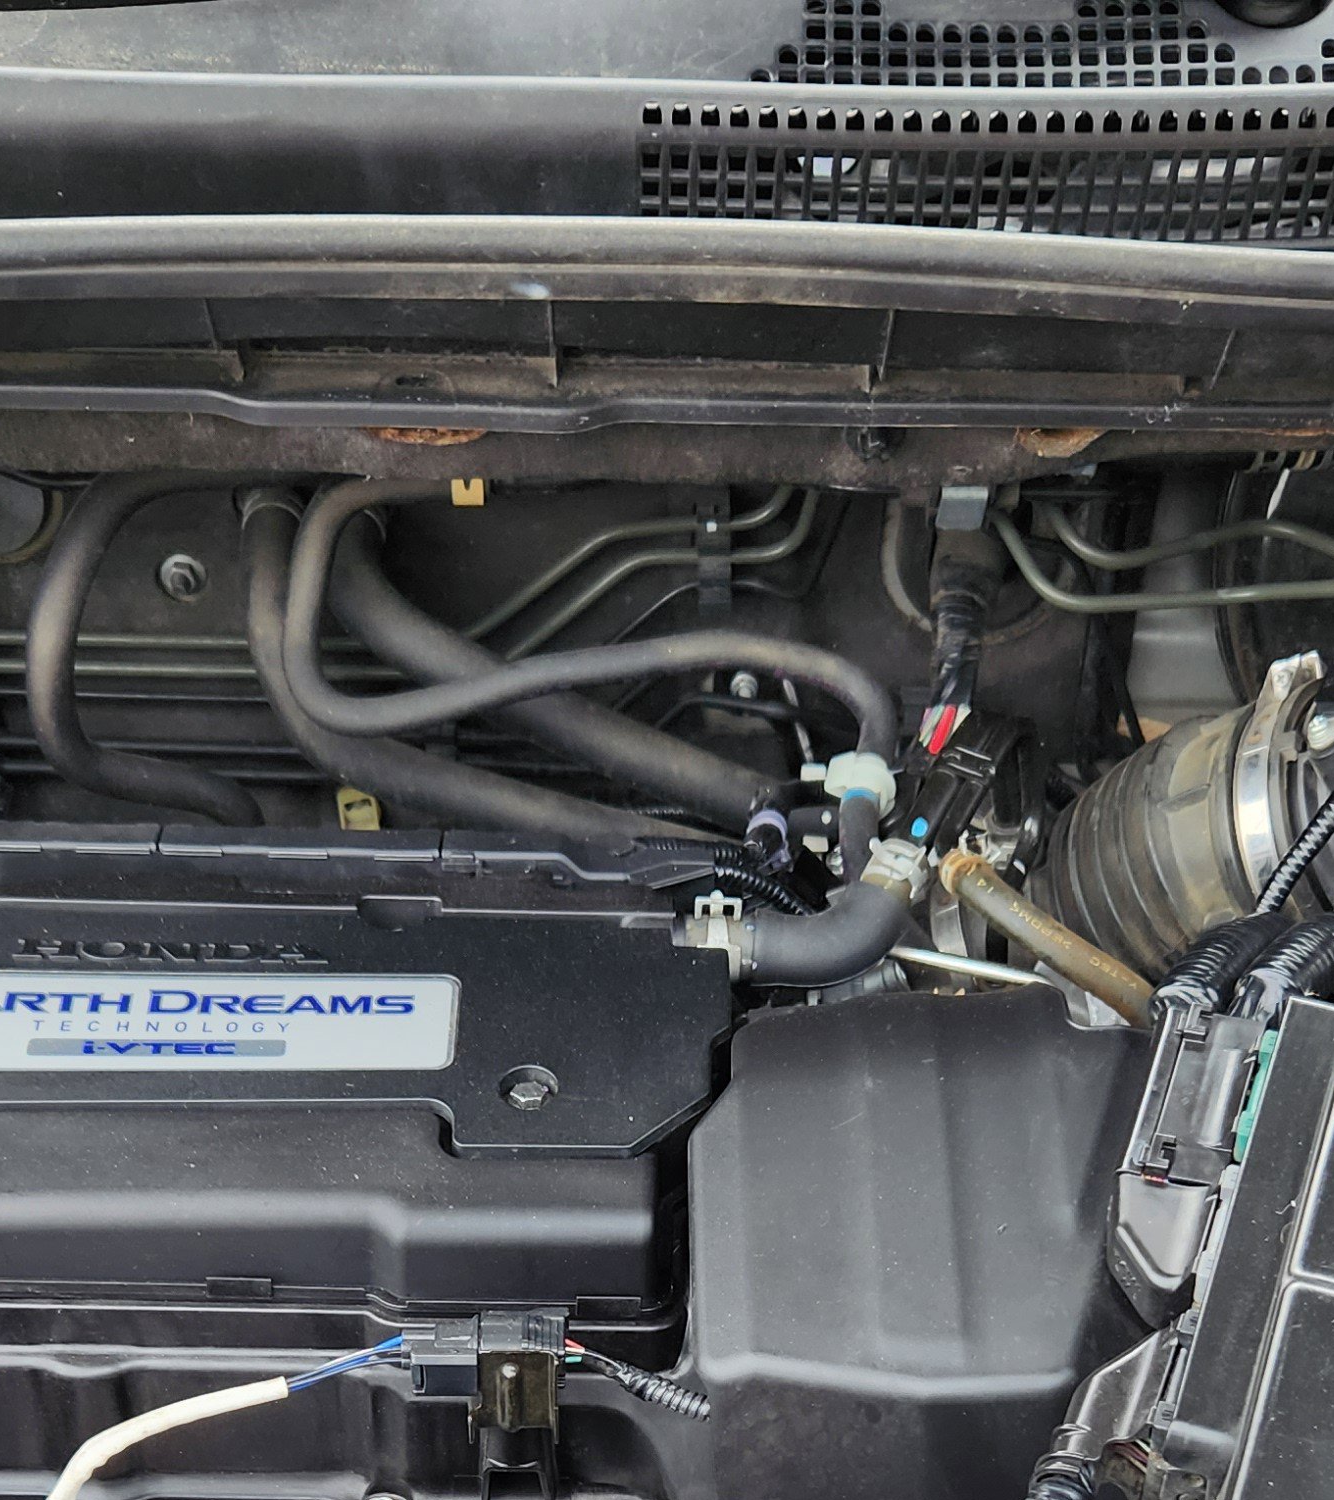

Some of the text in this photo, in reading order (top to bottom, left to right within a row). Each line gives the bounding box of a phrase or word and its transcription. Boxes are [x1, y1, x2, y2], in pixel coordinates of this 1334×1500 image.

[12, 938, 330, 965] HONDA
[147, 989, 416, 1016] DREAMS
[33, 1020, 291, 1033] TECHNOLOGY
[82, 1040, 236, 1056] i-VTEC
